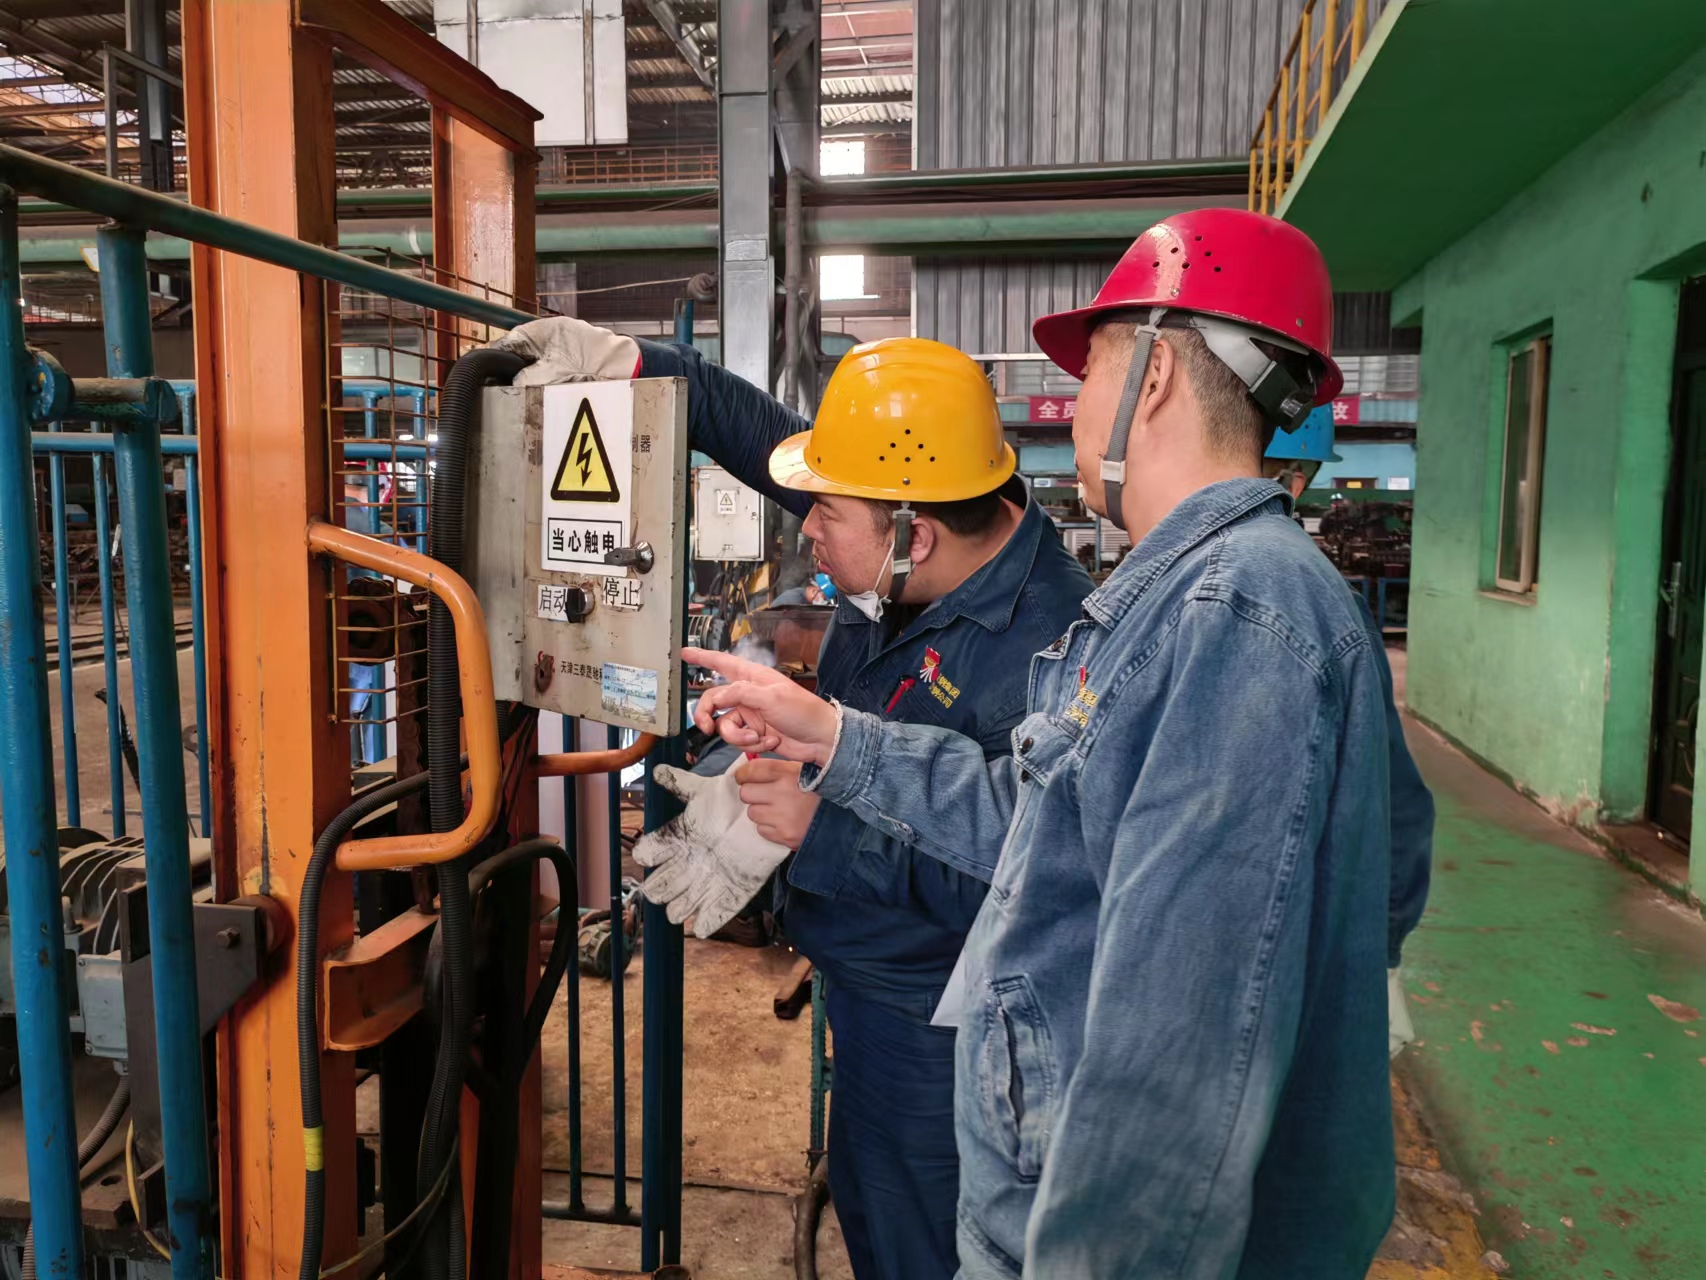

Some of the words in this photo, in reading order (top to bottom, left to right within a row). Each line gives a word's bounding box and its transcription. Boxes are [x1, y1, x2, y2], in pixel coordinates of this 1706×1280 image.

[552, 527, 615, 554] 当心触电
[540, 586, 567, 613] 启动
[603, 577, 641, 609] 停止
